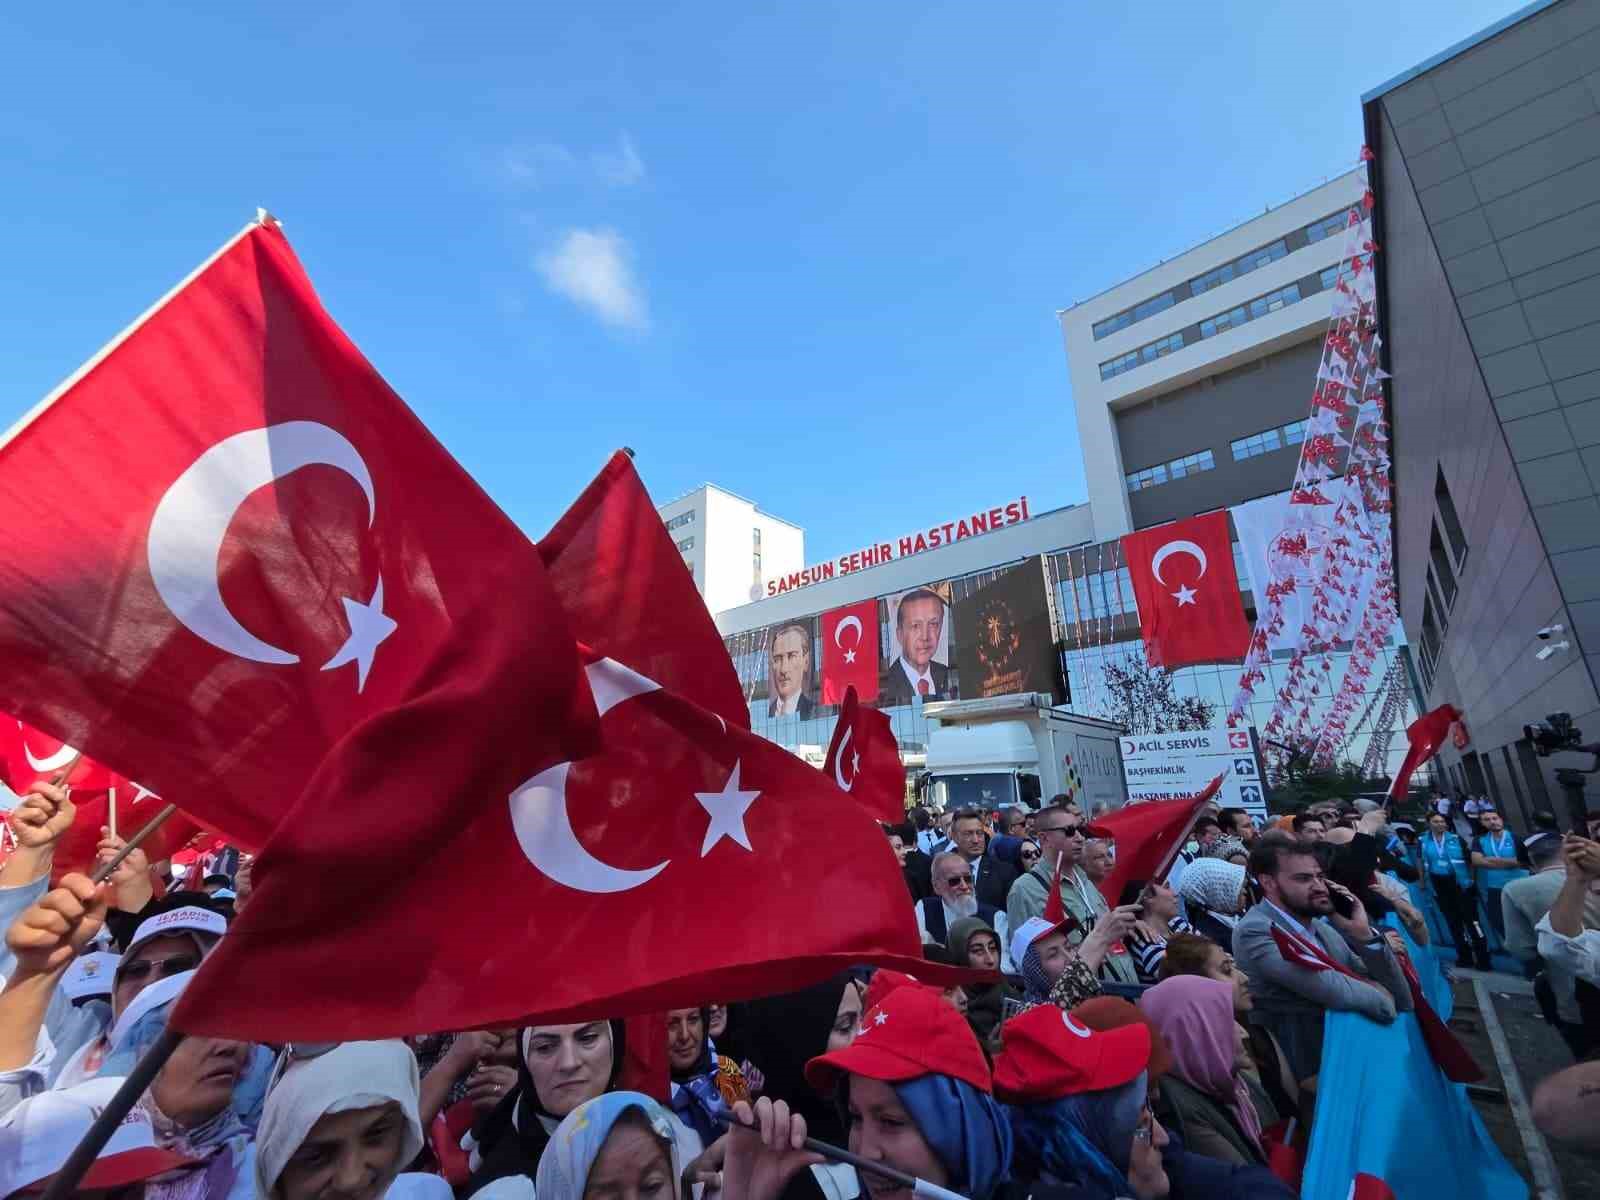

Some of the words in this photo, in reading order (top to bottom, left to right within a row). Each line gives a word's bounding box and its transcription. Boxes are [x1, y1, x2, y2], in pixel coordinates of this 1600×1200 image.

[768, 561, 833, 596] SAMSUN
[839, 543, 892, 576] ŞEHİR
[899, 496, 1029, 556] HASTANESİ
[1138, 739, 1165, 753] ACİL
[1167, 736, 1211, 751] SERVİS
[1127, 764, 1187, 777] BAŞHEKİMLİK
[1131, 791, 1173, 801] HASTANE
